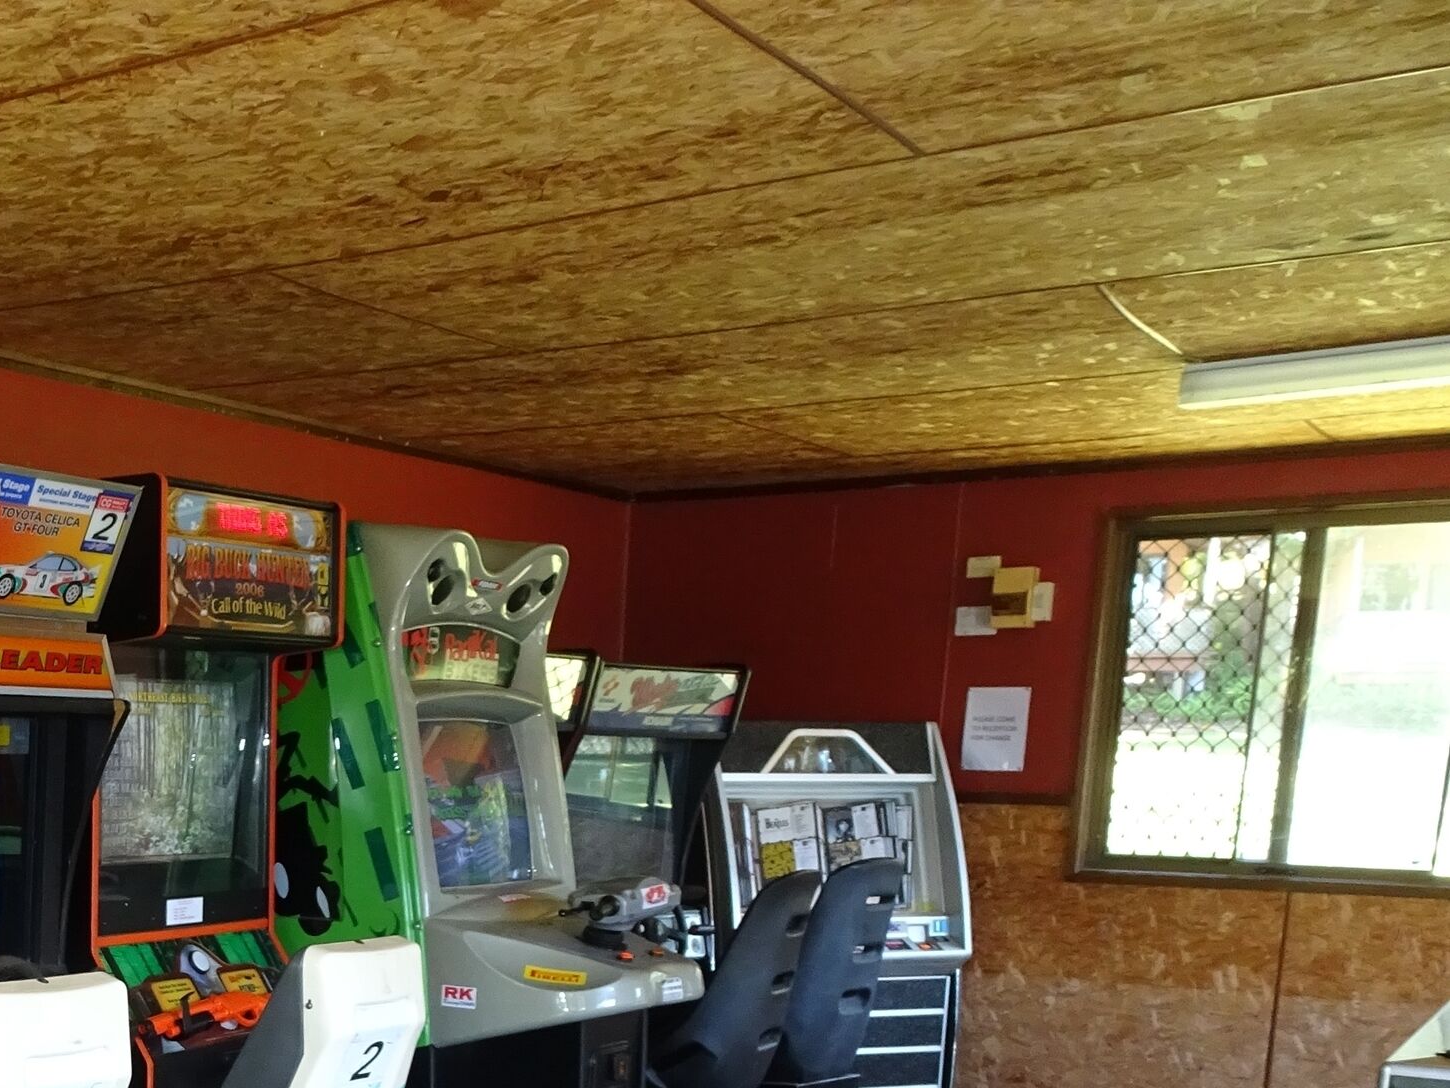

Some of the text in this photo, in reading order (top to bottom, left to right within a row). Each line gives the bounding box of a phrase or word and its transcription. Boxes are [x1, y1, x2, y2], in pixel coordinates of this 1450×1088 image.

[2, 478, 31, 493] Stage
[37, 484, 97, 502] Special Stage
[1, 507, 81, 527] TOYOTA CELICA
[92, 512, 118, 541] 2
[211, 596, 287, 620] Call of the Wild
[530, 969, 581, 983] PIRELLI
[443, 987, 473, 1001] RK
[349, 1041, 384, 1081] 2
